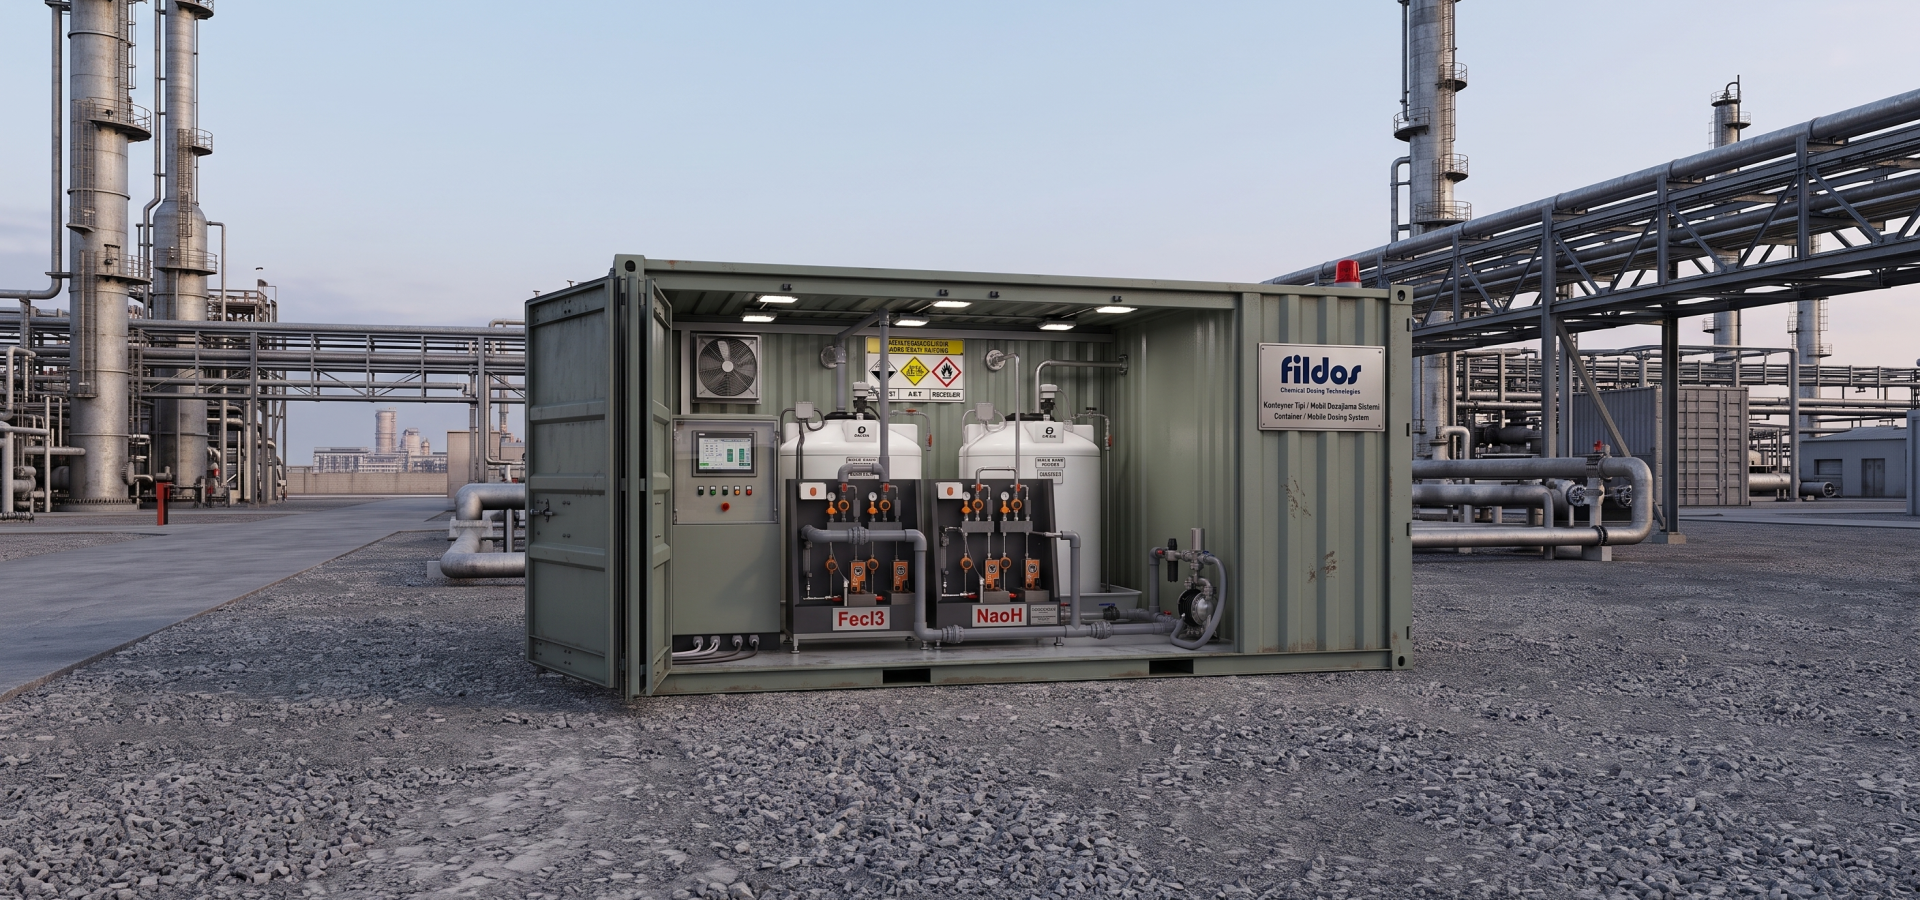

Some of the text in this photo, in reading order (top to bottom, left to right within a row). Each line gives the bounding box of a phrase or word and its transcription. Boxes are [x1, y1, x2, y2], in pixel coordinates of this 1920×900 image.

[1281, 354, 1361, 385] fildos
[1263, 401, 1293, 410] Konteyner
[1295, 402, 1305, 410] Tipi
[1327, 414, 1347, 422] Dosing
[1348, 414, 1369, 422] System
[838, 611, 884, 626] Fecl3
[977, 607, 1022, 623] NaoH
